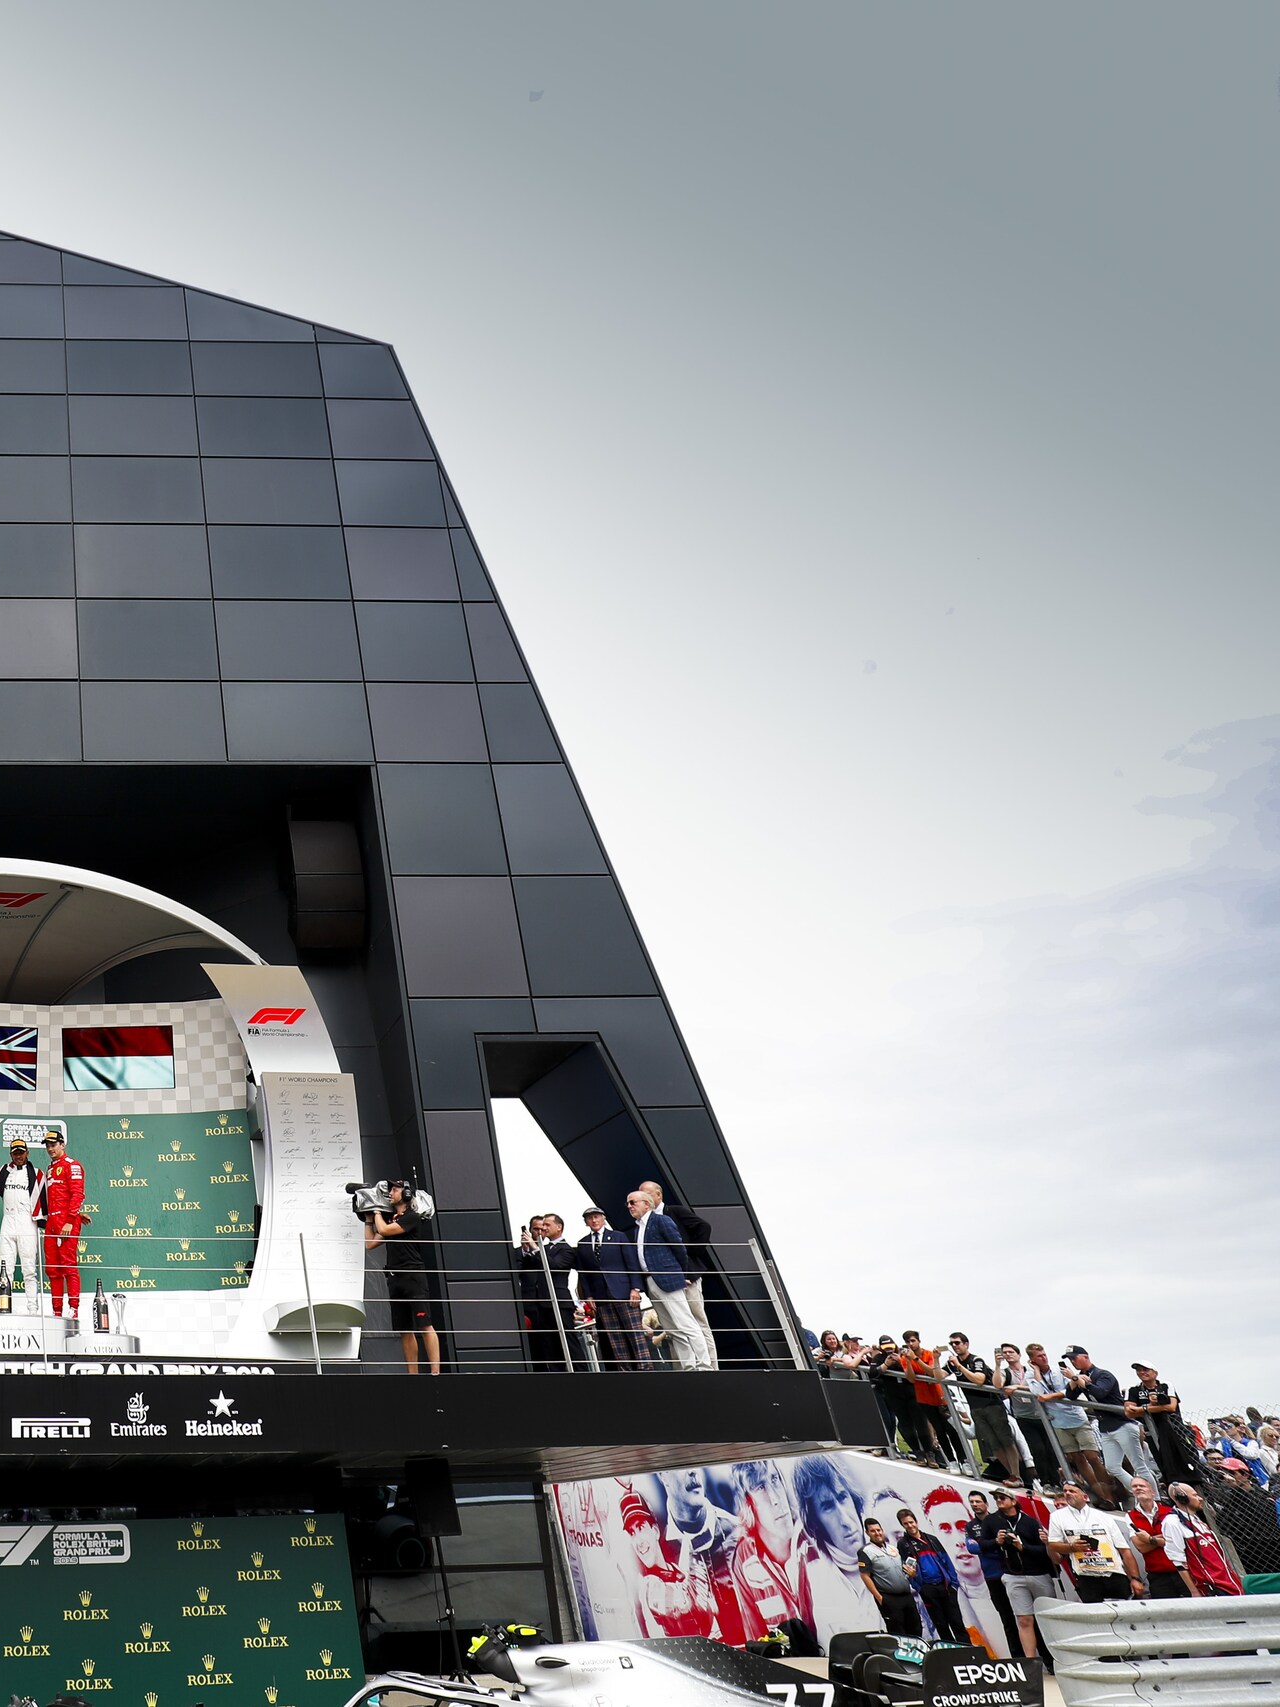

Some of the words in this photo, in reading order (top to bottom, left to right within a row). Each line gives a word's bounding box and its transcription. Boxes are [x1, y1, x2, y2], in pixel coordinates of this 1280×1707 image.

[2, 1124, 42, 1132] FORMULA
[205, 1126, 244, 1136] ROLEX
[107, 1131, 144, 1140] ROLEX
[158, 1153, 196, 1162] ROLEX
[110, 1178, 148, 1188] ROLEX
[210, 1174, 249, 1184] ROLEX
[79, 1204, 100, 1213] LEX
[162, 1202, 201, 1210] ROLEX
[112, 1228, 152, 1237] ROLEX
[216, 1224, 254, 1234] ROLEX
[166, 1252, 206, 1261] ROLEX
[116, 1280, 156, 1288] ROLEX
[12, 1418, 92, 1438] PIRELLI
[110, 1422, 168, 1436] Emirates
[185, 1420, 262, 1436] Heineken
[53, 1532, 100, 1540] FORMULA
[101, 1532, 107, 1540] 1
[290, 1536, 334, 1547] ROLEX
[86, 1540, 123, 1548] BRITISH
[177, 1538, 221, 1550] ROLEX
[53, 1548, 88, 1556] GRAND
[88, 1548, 111, 1556] PRIX
[54, 1556, 78, 1564] 2019
[237, 1570, 281, 1582] ROLEX
[182, 1604, 227, 1616] ROLEX
[298, 1600, 342, 1612] ROLEX
[63, 1609, 110, 1620] ROLEX
[124, 1641, 171, 1654] ROLEX
[243, 1636, 289, 1648] ROLEX
[4, 1645, 50, 1657] ROLEX
[187, 1673, 234, 1686] ROLEX
[306, 1668, 352, 1680] ROLEX
[953, 1662, 1027, 1686] EPSON
[66, 1678, 113, 1690] ROLEX
[932, 1690, 1021, 1707] CROWDSTRIKE
